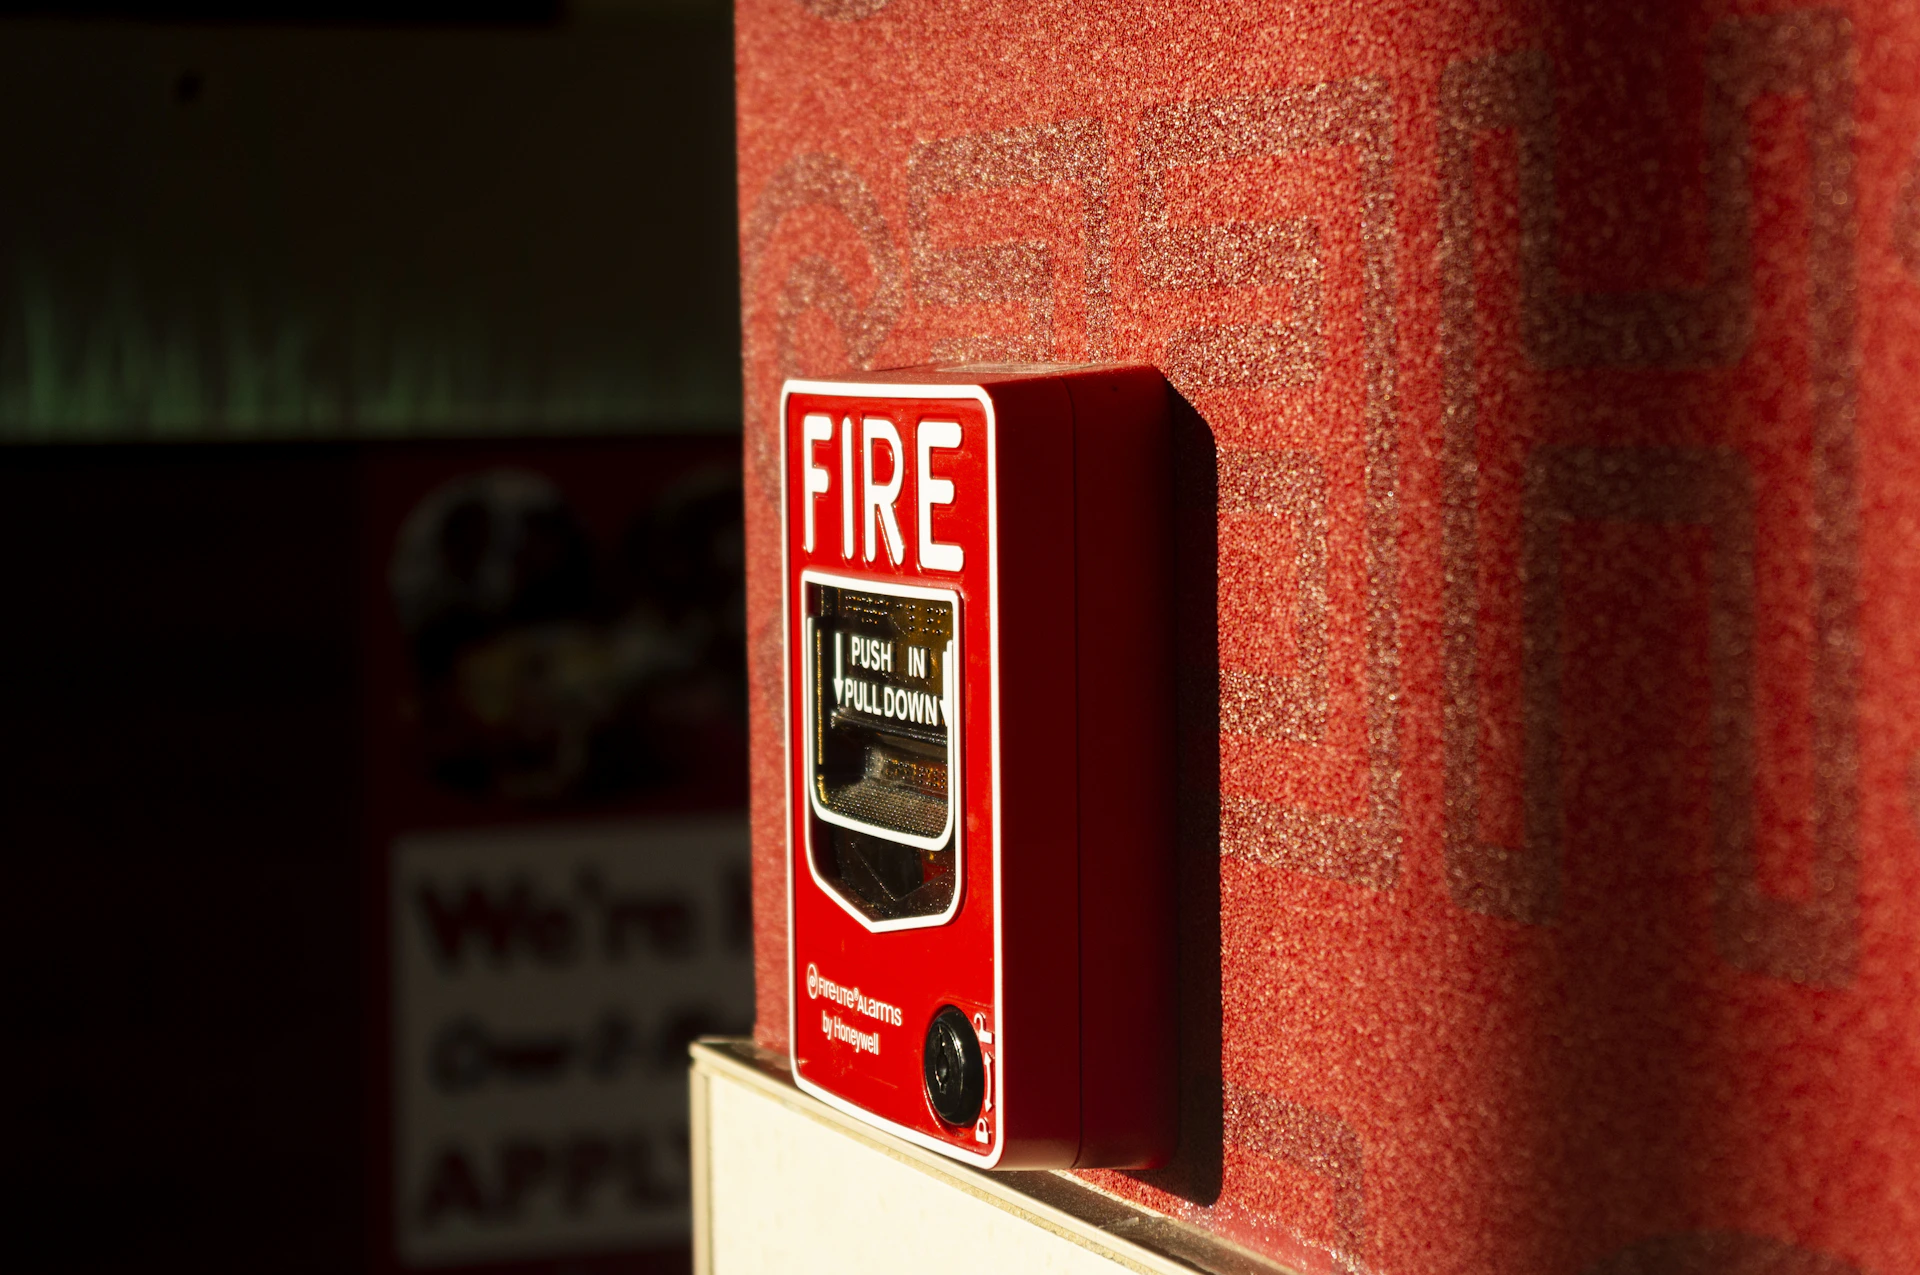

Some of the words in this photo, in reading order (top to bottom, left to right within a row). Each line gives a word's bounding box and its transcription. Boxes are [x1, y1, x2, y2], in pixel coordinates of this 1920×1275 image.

[803, 415, 964, 572] FIRE
[851, 636, 892, 673] PUSH
[908, 646, 925, 679] IN
[845, 678, 882, 716] PULL
[884, 686, 938, 727] DOWN
[822, 1010, 833, 1040] by
[834, 1016, 879, 1056] Honeywell
